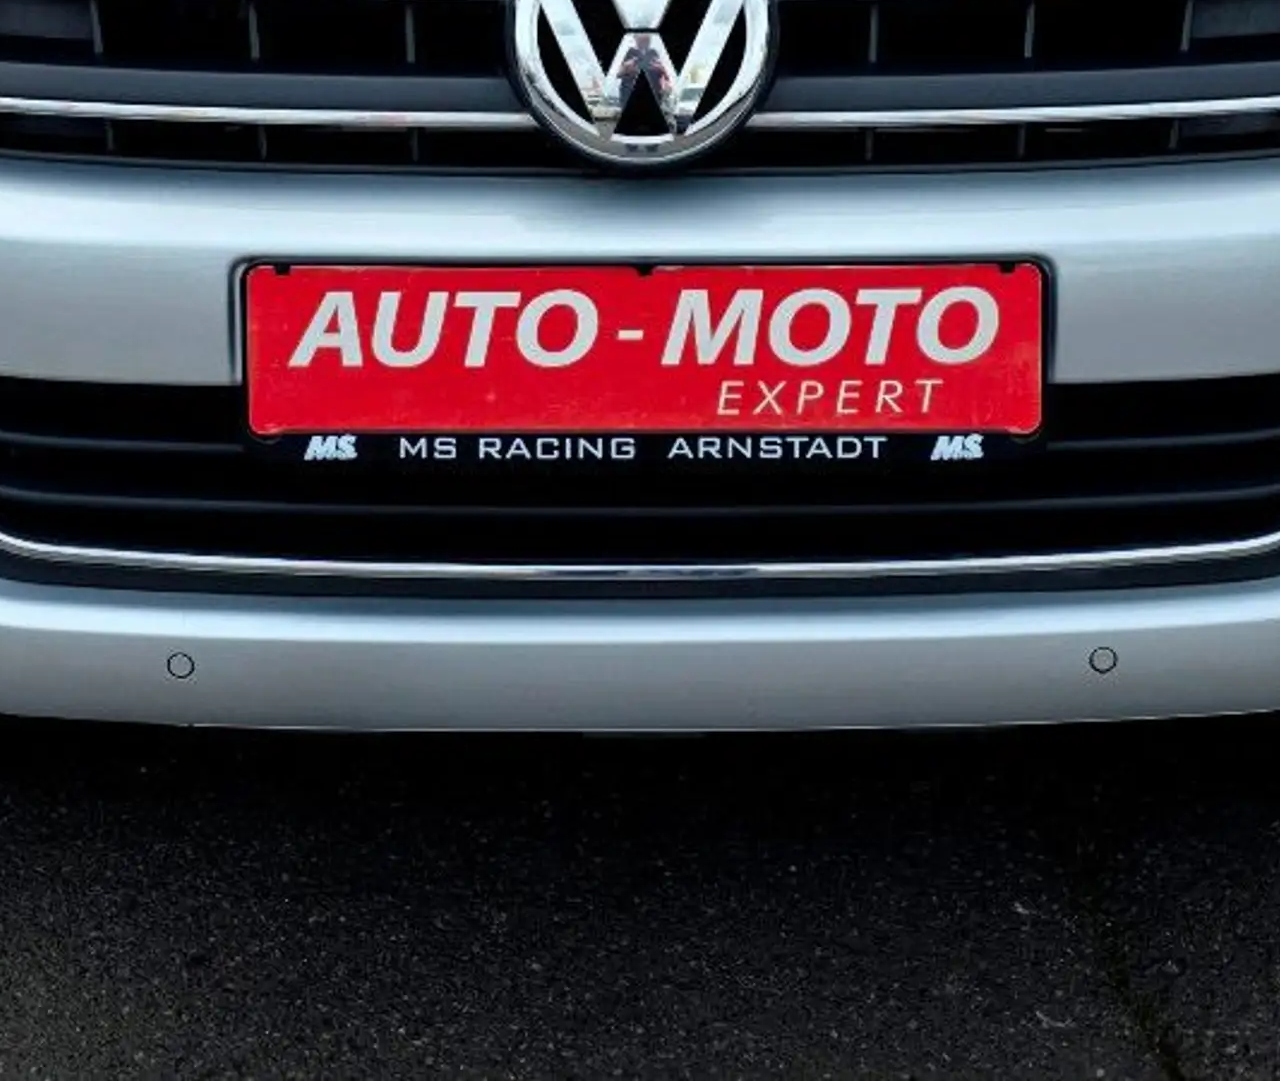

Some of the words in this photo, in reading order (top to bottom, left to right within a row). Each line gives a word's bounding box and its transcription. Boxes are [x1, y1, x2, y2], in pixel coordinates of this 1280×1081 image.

[287, 288, 599, 368] AUTO
[660, 285, 1000, 367] MOTO
[716, 377, 945, 416] EXPERT
[399, 437, 457, 460] MS
[478, 436, 637, 460] RACING
[667, 436, 888, 460] ARNSTADT
